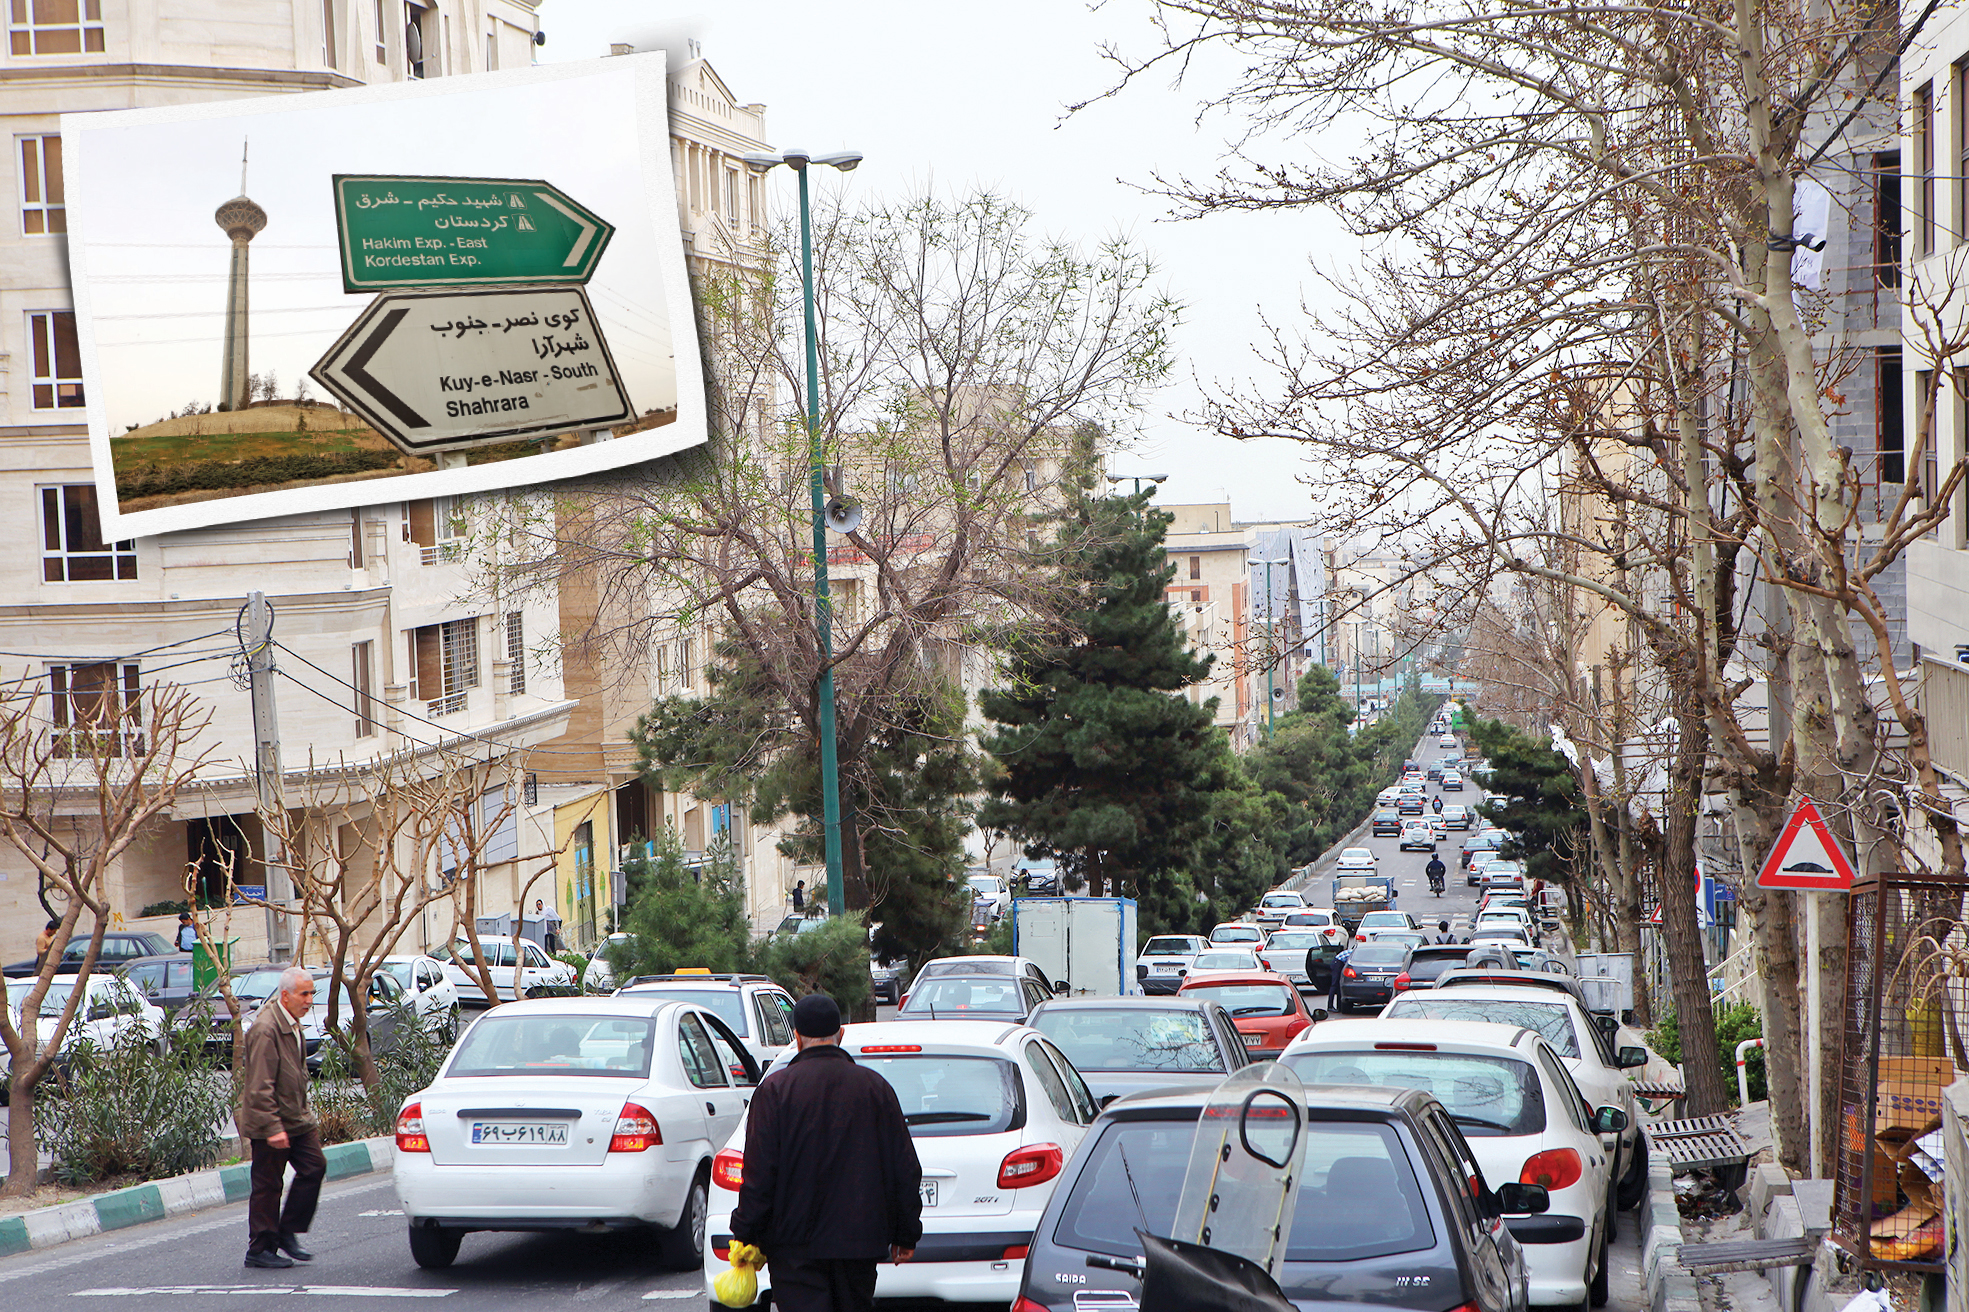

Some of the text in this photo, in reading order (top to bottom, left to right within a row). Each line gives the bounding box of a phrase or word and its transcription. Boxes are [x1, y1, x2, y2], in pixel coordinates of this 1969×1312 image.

[355, 191, 400, 209] شرق
[417, 193, 459, 211] حکیم
[462, 193, 503, 209] شهید
[435, 215, 509, 232] کردستان
[362, 237, 412, 250] Hakim
[414, 237, 447, 251] Exp.
[456, 237, 489, 249] East
[365, 253, 482, 267] Kordestan Exp.
[544, 308, 579, 331] کوی
[531, 333, 590, 360] شهرآرا
[439, 370, 539, 393] Kuy-e-Nasr
[550, 362, 599, 380] South
[446, 395, 530, 417] Shahrara
[1055, 1273, 1087, 1285] SAIPA
